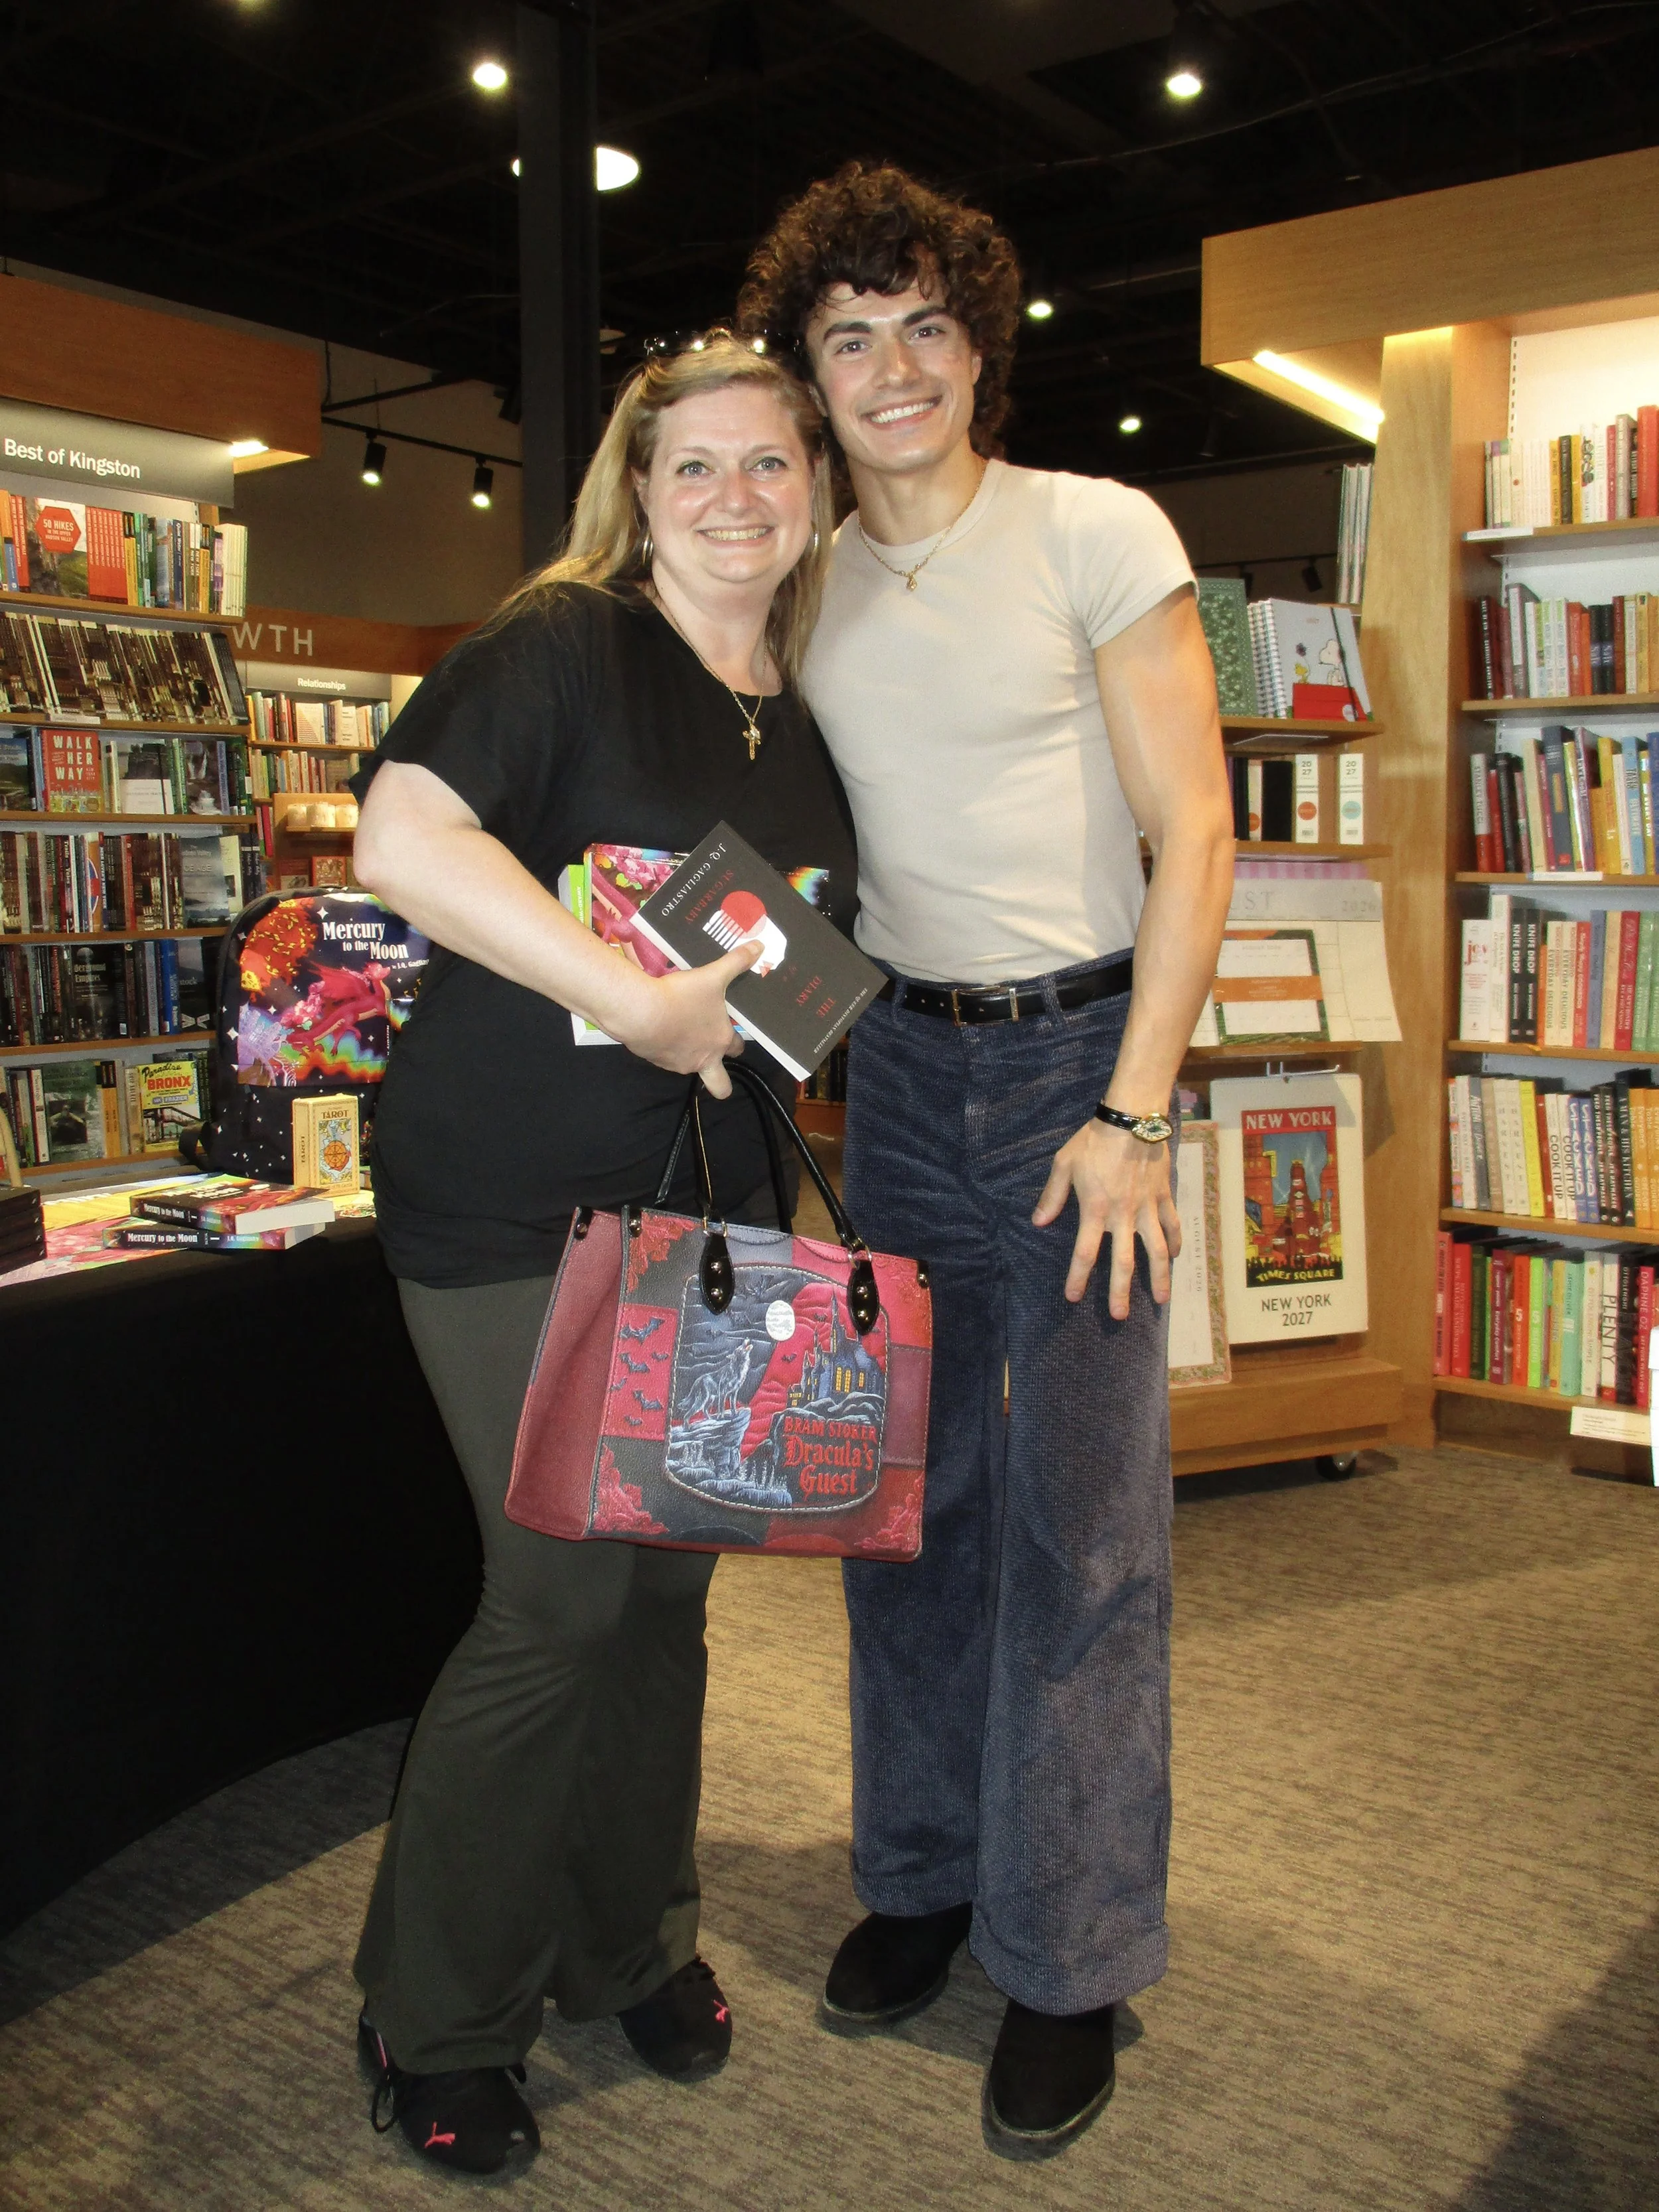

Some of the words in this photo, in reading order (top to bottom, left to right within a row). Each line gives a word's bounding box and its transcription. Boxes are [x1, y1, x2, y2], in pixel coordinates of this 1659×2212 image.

[4, 439, 44, 462] Best
[48, 449, 66, 464] of
[70, 450, 141, 479] Kingston
[43, 519, 52, 528] 50
[54, 520, 74, 531] HIKES
[297, 677, 346, 691] Relationships
[53, 735, 92, 750] WALK
[67, 751, 93, 765] HER
[55, 766, 84, 780] WAY
[709, 842, 727, 862] J.Q.
[660, 862, 711, 917] GAGLIASTRO
[683, 868, 734, 924] SUGARBABY
[322, 921, 386, 943] Mercury
[342, 941, 352, 952] to
[354, 938, 369, 951] the
[369, 941, 409, 961] Moon
[794, 975, 822, 1006] DIARY
[815, 997, 835, 1018] THE
[141, 1062, 182, 1083] Paradise
[147, 1075, 192, 1091] BRONX
[321, 1109, 349, 1119] TAROT
[1246, 1113, 1283, 1130] NEW
[1289, 1111, 1333, 1128] YORK
[1619, 1105, 1628, 1126] MAN
[1550, 1135, 1560, 1168] COOK
[1563, 1135, 1573, 1170] COOK
[1621, 1137, 1630, 1154] HIS
[1553, 1171, 1561, 1182] IT
[1566, 1172, 1574, 1182] IT
[1622, 1155, 1634, 1199] KITCHEN
[1553, 1184, 1563, 1200] UP
[1567, 1185, 1575, 1201] UP
[143, 1203, 160, 1215] Mercury
[172, 1209, 185, 1219] Moon
[128, 1233, 157, 1243] Mercury
[165, 1233, 176, 1243] the
[178, 1233, 198, 1243] Moon
[1256, 1269, 1291, 1282] TIMES
[1294, 1269, 1335, 1280] SQUARE
[1640, 1271, 1650, 1314] DAPHNE
[1261, 1296, 1294, 1312] NEW
[1296, 1293, 1333, 1310] YORK
[1282, 1310, 1313, 1327] 2027
[1640, 1316, 1648, 1330] OZ
[1602, 1295, 1617, 1365] PLENTY
[783, 1416, 825, 1439] BRAM
[828, 1420, 878, 1444] STOKER
[782, 1432, 874, 1476] Dracula's
[798, 1466, 857, 1501] Guest
